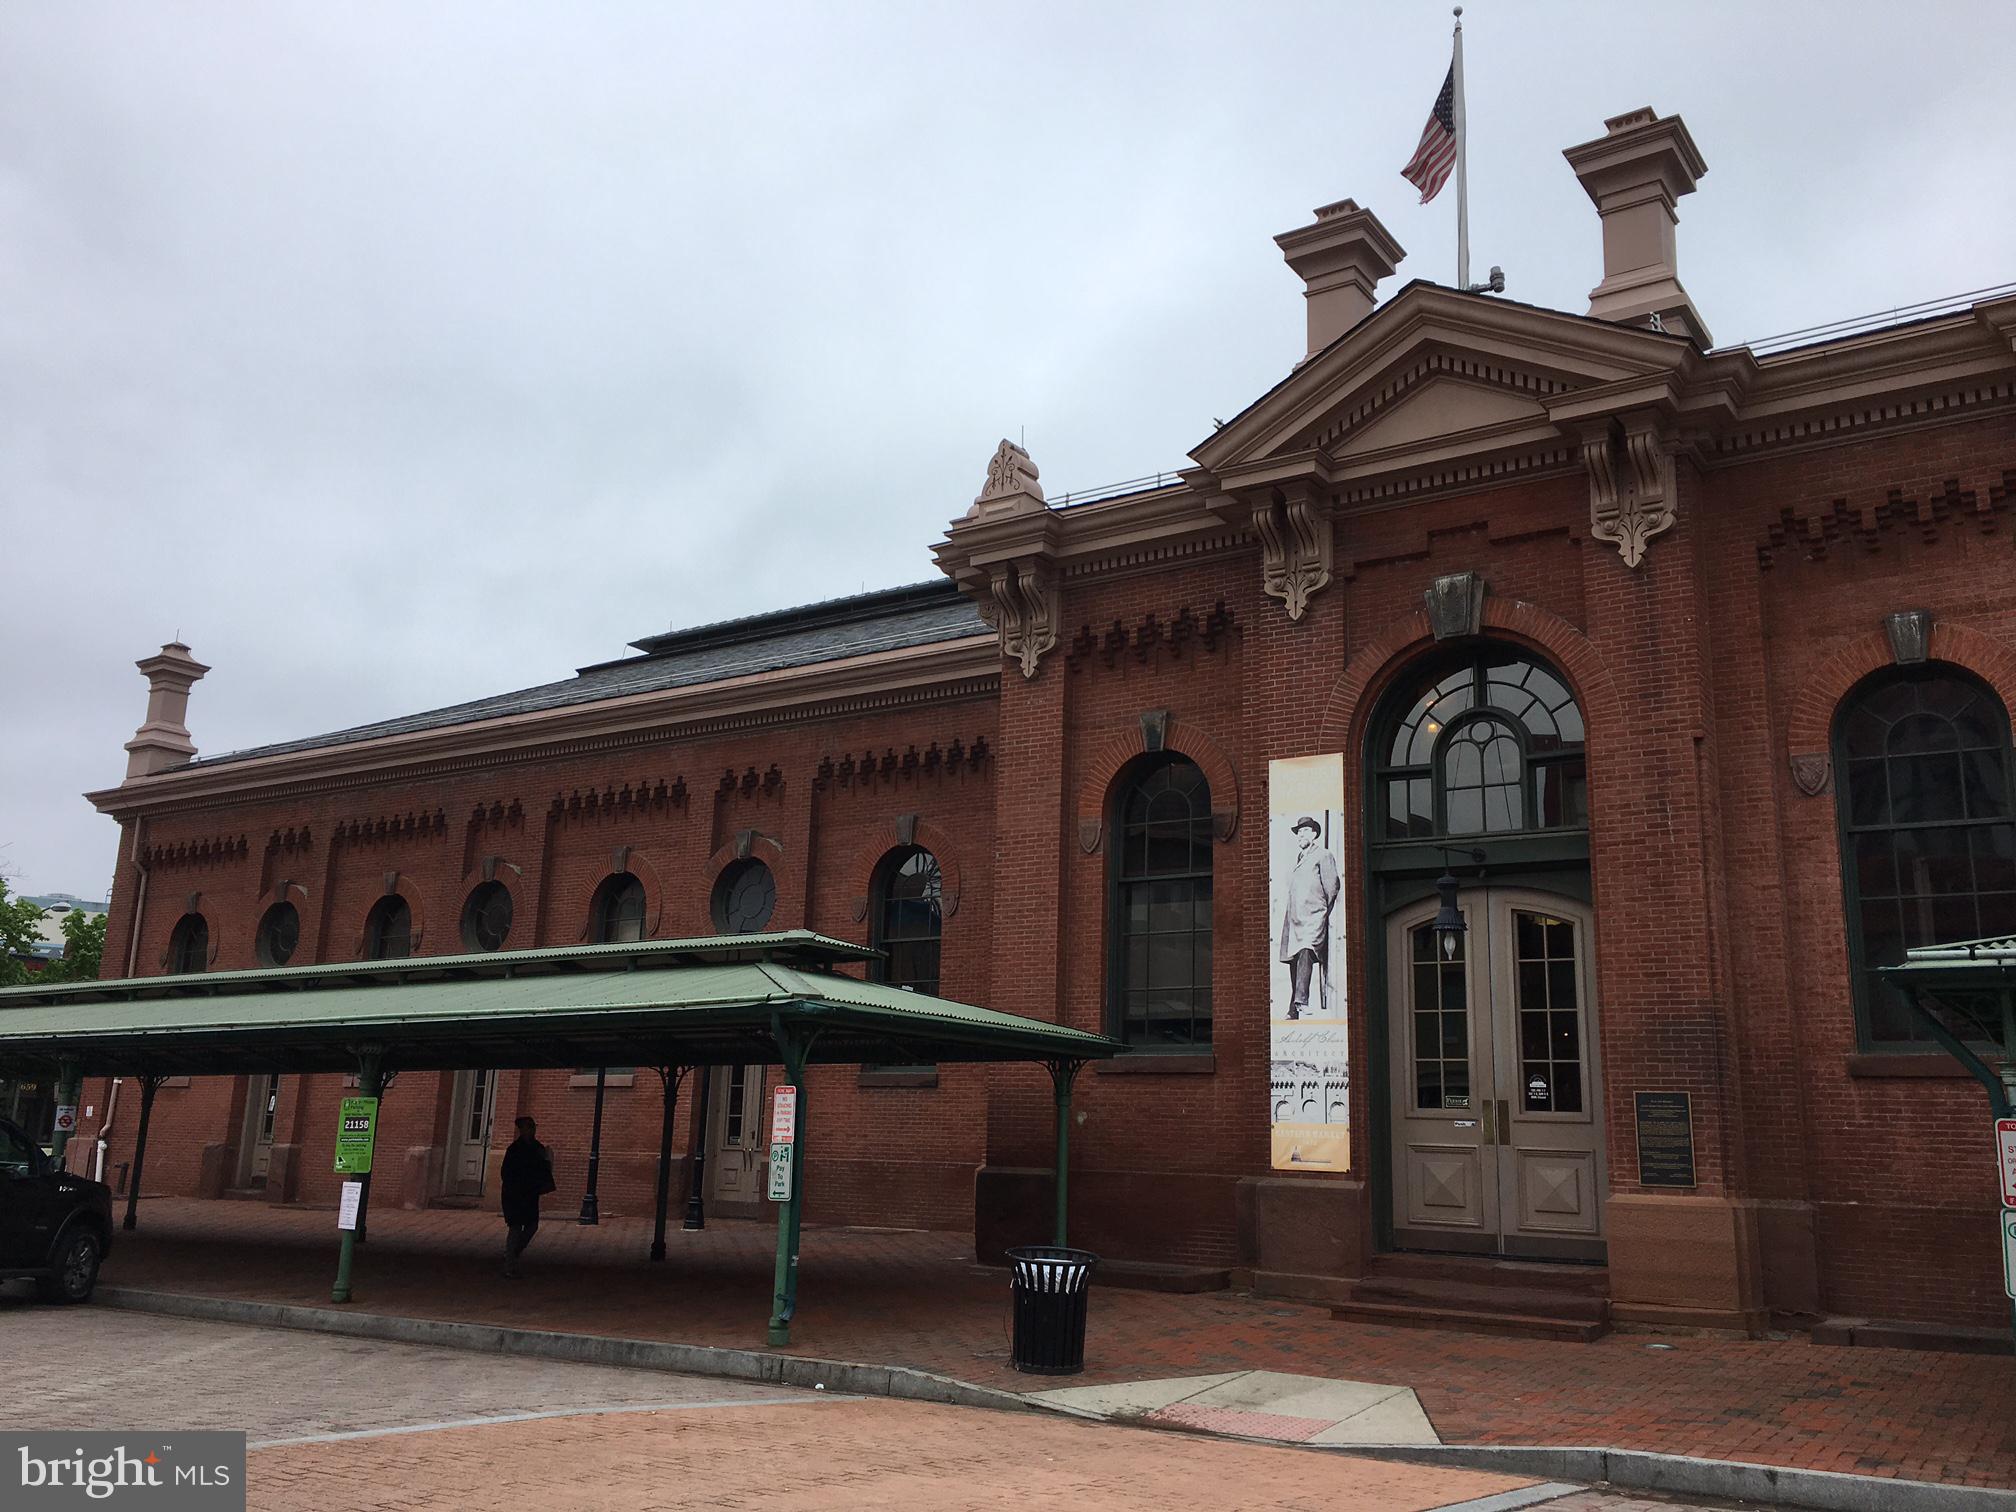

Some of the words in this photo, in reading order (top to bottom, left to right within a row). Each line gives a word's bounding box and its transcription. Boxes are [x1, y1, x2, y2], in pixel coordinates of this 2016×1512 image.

[1274, 1049, 1345, 1057] ARCHITECT
[345, 1120, 369, 1129] 21158
[2006, 1122, 2016, 1130] TO
[776, 1164, 785, 1173] Pay
